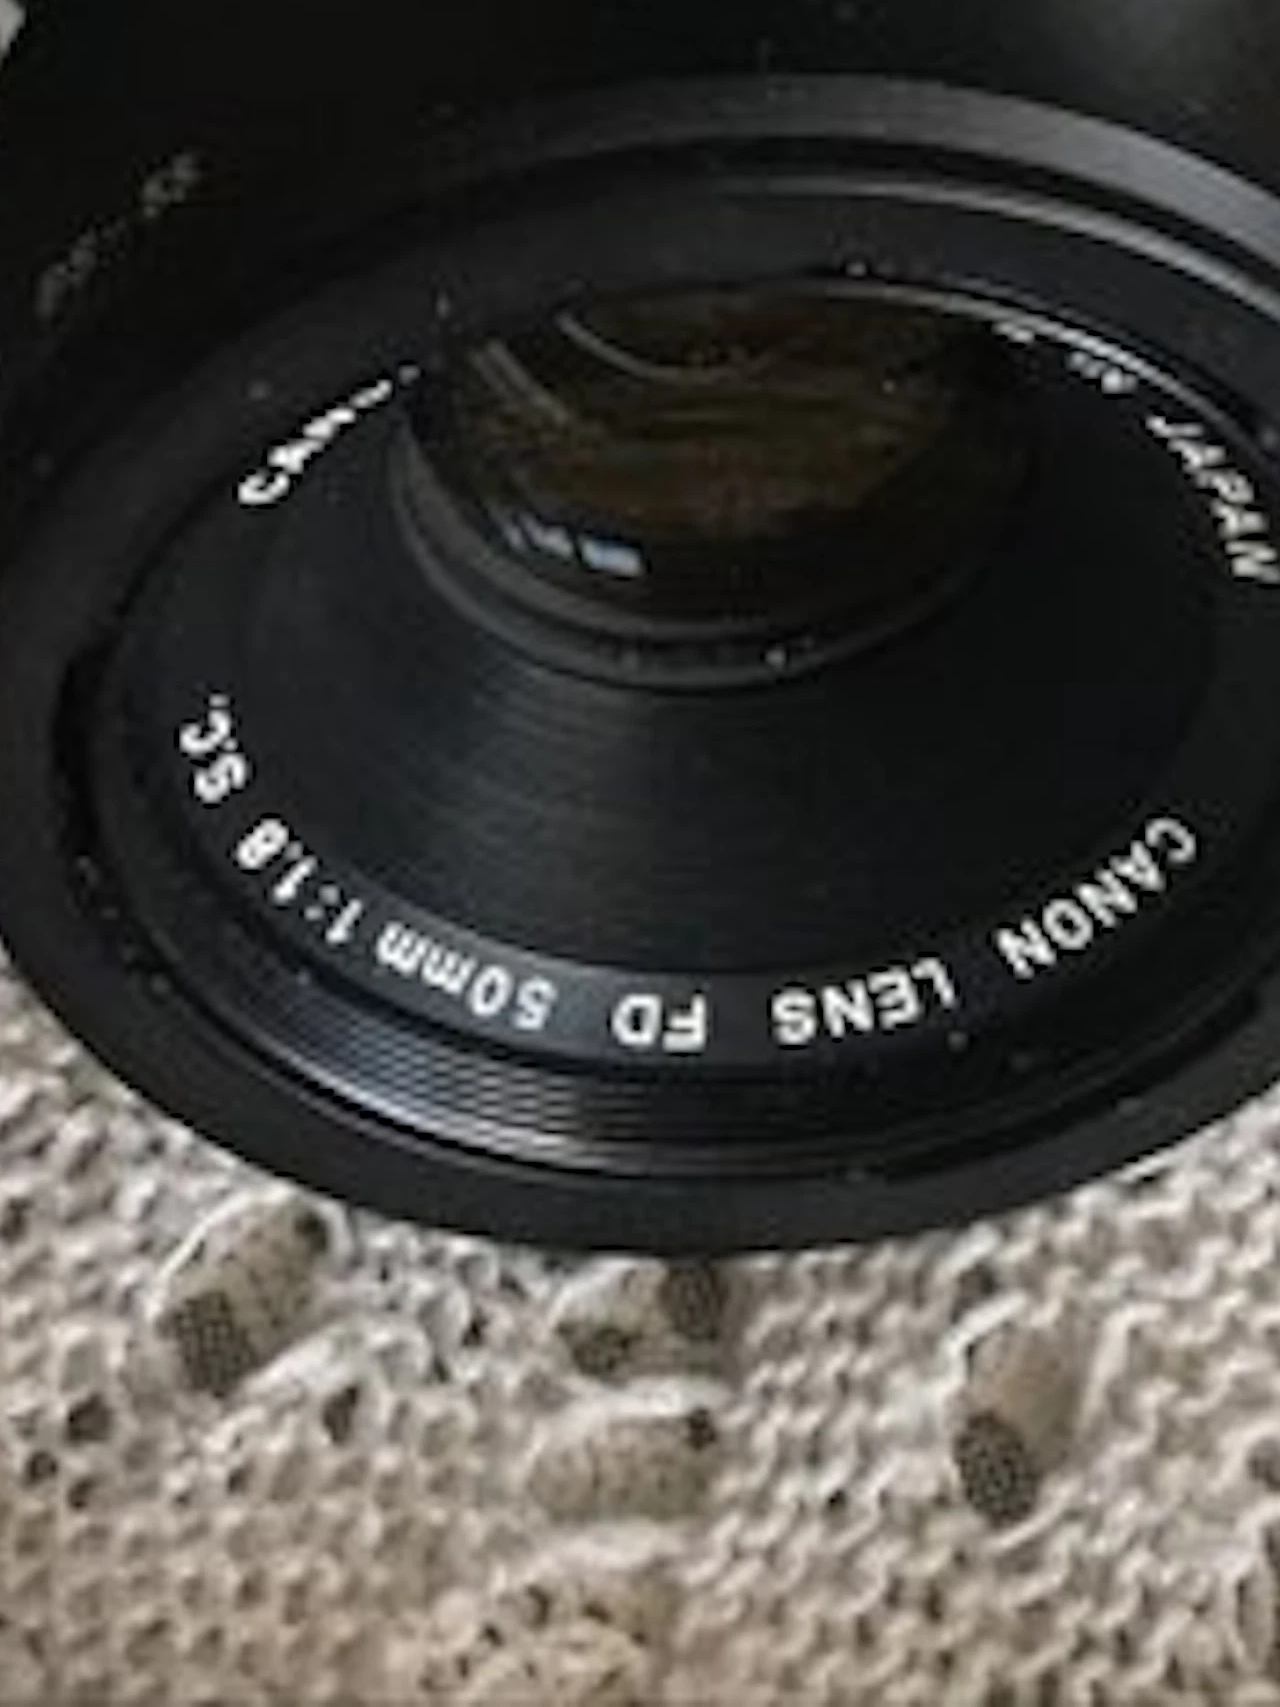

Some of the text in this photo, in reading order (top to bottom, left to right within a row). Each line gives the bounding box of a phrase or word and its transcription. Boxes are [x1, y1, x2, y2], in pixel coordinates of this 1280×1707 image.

[994, 813, 1198, 981] CANON
[376, 921, 560, 1031] 50mm
[610, 990, 710, 1054] FD
[770, 955, 958, 1047] LENS
